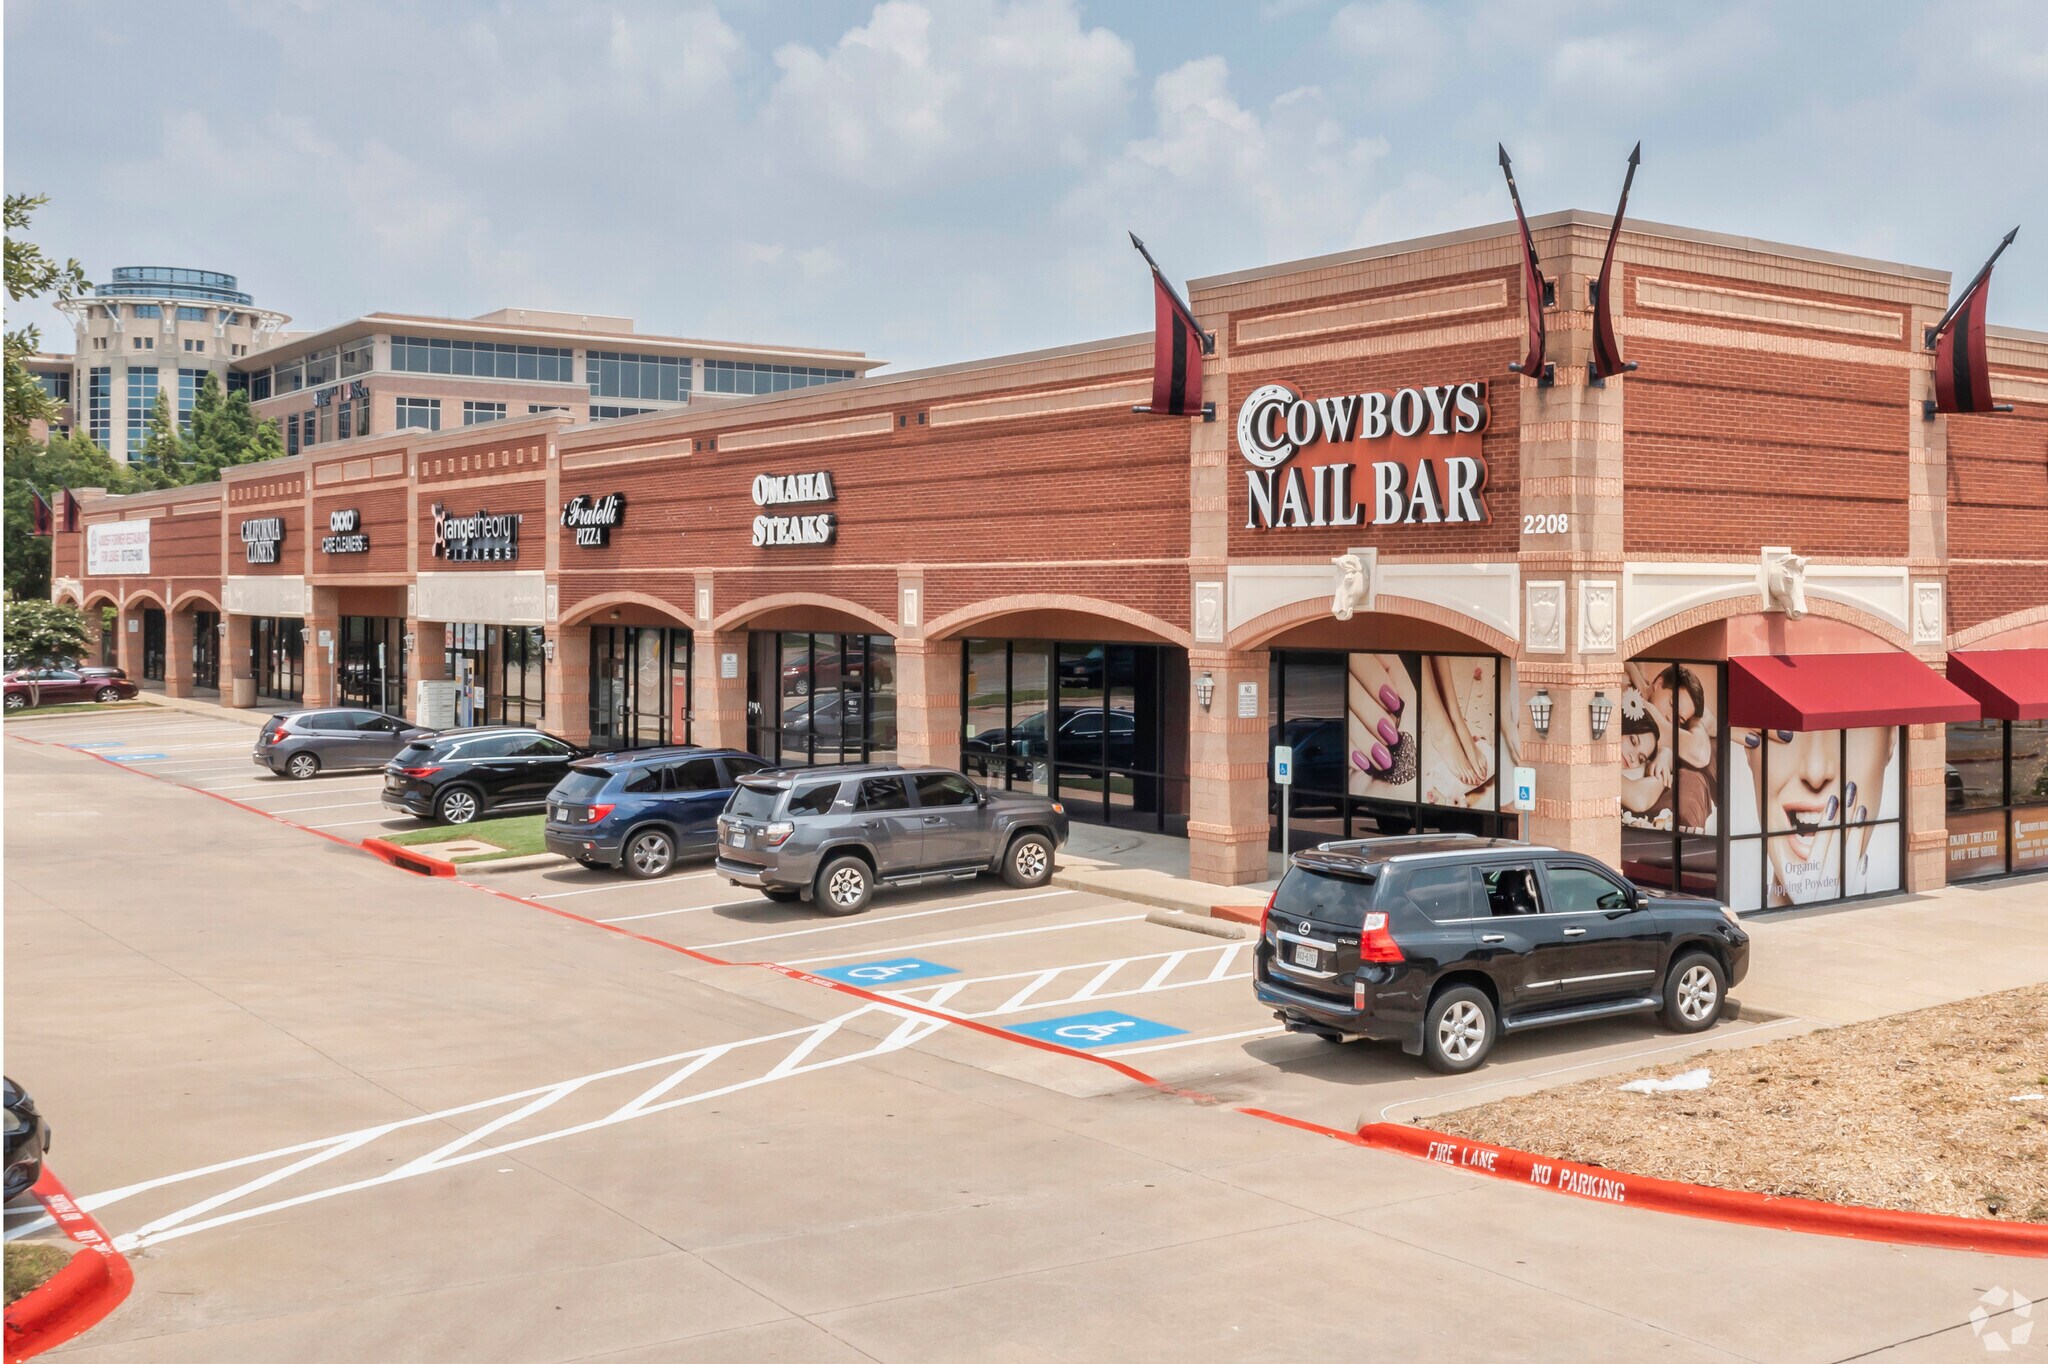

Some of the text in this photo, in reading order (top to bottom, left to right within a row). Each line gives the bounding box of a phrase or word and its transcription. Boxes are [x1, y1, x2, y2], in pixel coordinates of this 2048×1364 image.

[1257, 382, 1480, 446] COWBOYS
[752, 471, 830, 506] OMAHA
[1245, 456, 1481, 529] NAIL BAR
[330, 510, 354, 531] OXXO
[567, 496, 616, 526] Fratelli
[241, 518, 281, 543] CALIFORNIA
[752, 513, 830, 547] STEAKS
[1523, 513, 1568, 535] 2208
[576, 527, 601, 545] PIZZA
[247, 541, 275, 563] CLOSETS
[445, 547, 511, 560] FITNESS
[1244, 685, 1253, 694] NO
[1949, 830, 1998, 847] ENJOY THE STAY
[1951, 845, 1998, 861] LOVE THE SHINE
[1785, 860, 1821, 876] Organic
[1805, 875, 1840, 891] Powder
[1427, 1141, 1499, 1172] FIRE LANE
[1530, 1163, 1625, 1202] NO PARKING
